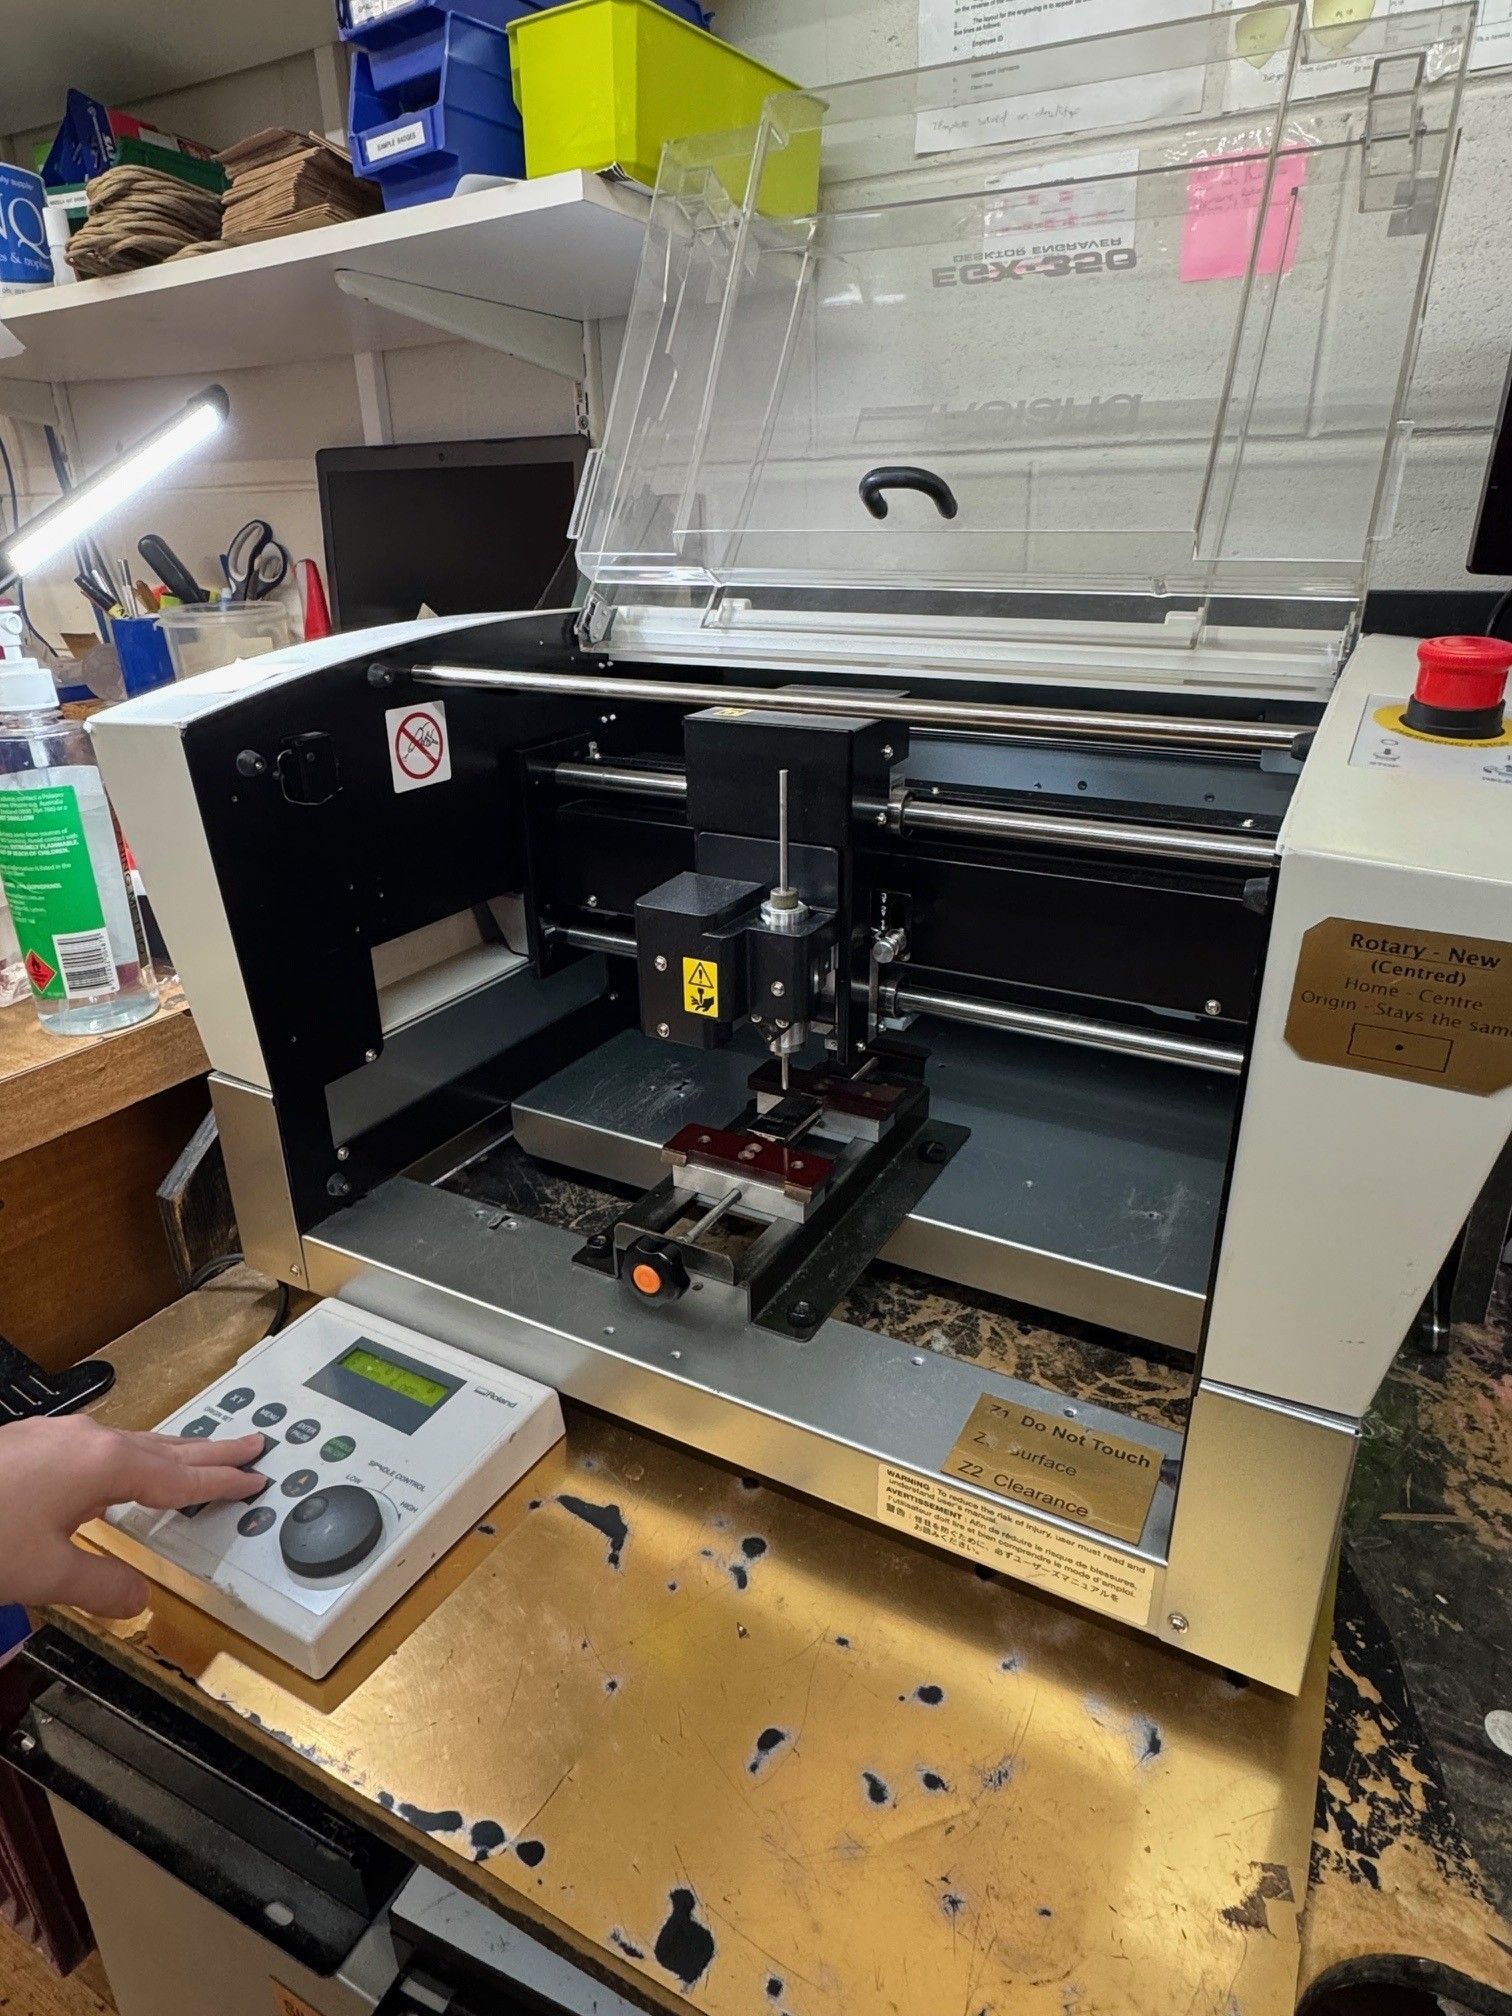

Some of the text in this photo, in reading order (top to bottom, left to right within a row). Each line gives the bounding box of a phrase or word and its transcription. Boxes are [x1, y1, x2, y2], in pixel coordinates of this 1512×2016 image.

[377, 138, 395, 151] SAMPLE
[1350, 933, 1427, 960] Rotary
[1448, 947, 1501, 969] New
[1371, 960, 1467, 988] (Centred)
[1344, 977, 1400, 998] Home
[1418, 989, 1483, 1012] Centre
[1301, 990, 1357, 1011] Origin
[1376, 1002, 1424, 1024] Stays
[1431, 1013, 1462, 1029] the
[230, 1394, 246, 1404] XY
[487, 1390, 518, 1409] Roland
[259, 1408, 281, 1422] MENU
[1020, 1415, 1047, 1432] Do
[1052, 1425, 1087, 1448] Not
[1092, 1438, 1151, 1469] Touch
[345, 1473, 363, 1485] LOW
[395, 1472, 426, 1492] CONTROL
[889, 1478, 935, 1500] understand
[957, 1459, 1089, 1518] Z2 Clearance
[400, 1500, 419, 1513] HIGH
[886, 1486, 963, 1520] AVERTISSEMENT
[988, 1526, 1000, 1535] de
[1045, 1548, 1073, 1564] risque
[1075, 1560, 1087, 1570] de
[887, 1468, 931, 1491] WARNING
[937, 1488, 947, 1497] To
[948, 1494, 978, 1509] reduce
[981, 1505, 995, 1515] the
[997, 1510, 1013, 1522] risk
[1015, 1519, 1024, 1527] of
[1055, 1535, 1075, 1546] user
[1078, 1543, 1101, 1557] must
[1103, 1553, 1125, 1566] read
[1127, 1561, 1146, 1574] and
[934, 1514, 951, 1524] doit
[967, 1526, 975, 1534] et
[977, 1531, 997, 1542] bien
[998, 1538, 1052, 1565] comprendre
[1064, 1565, 1091, 1580] mode
